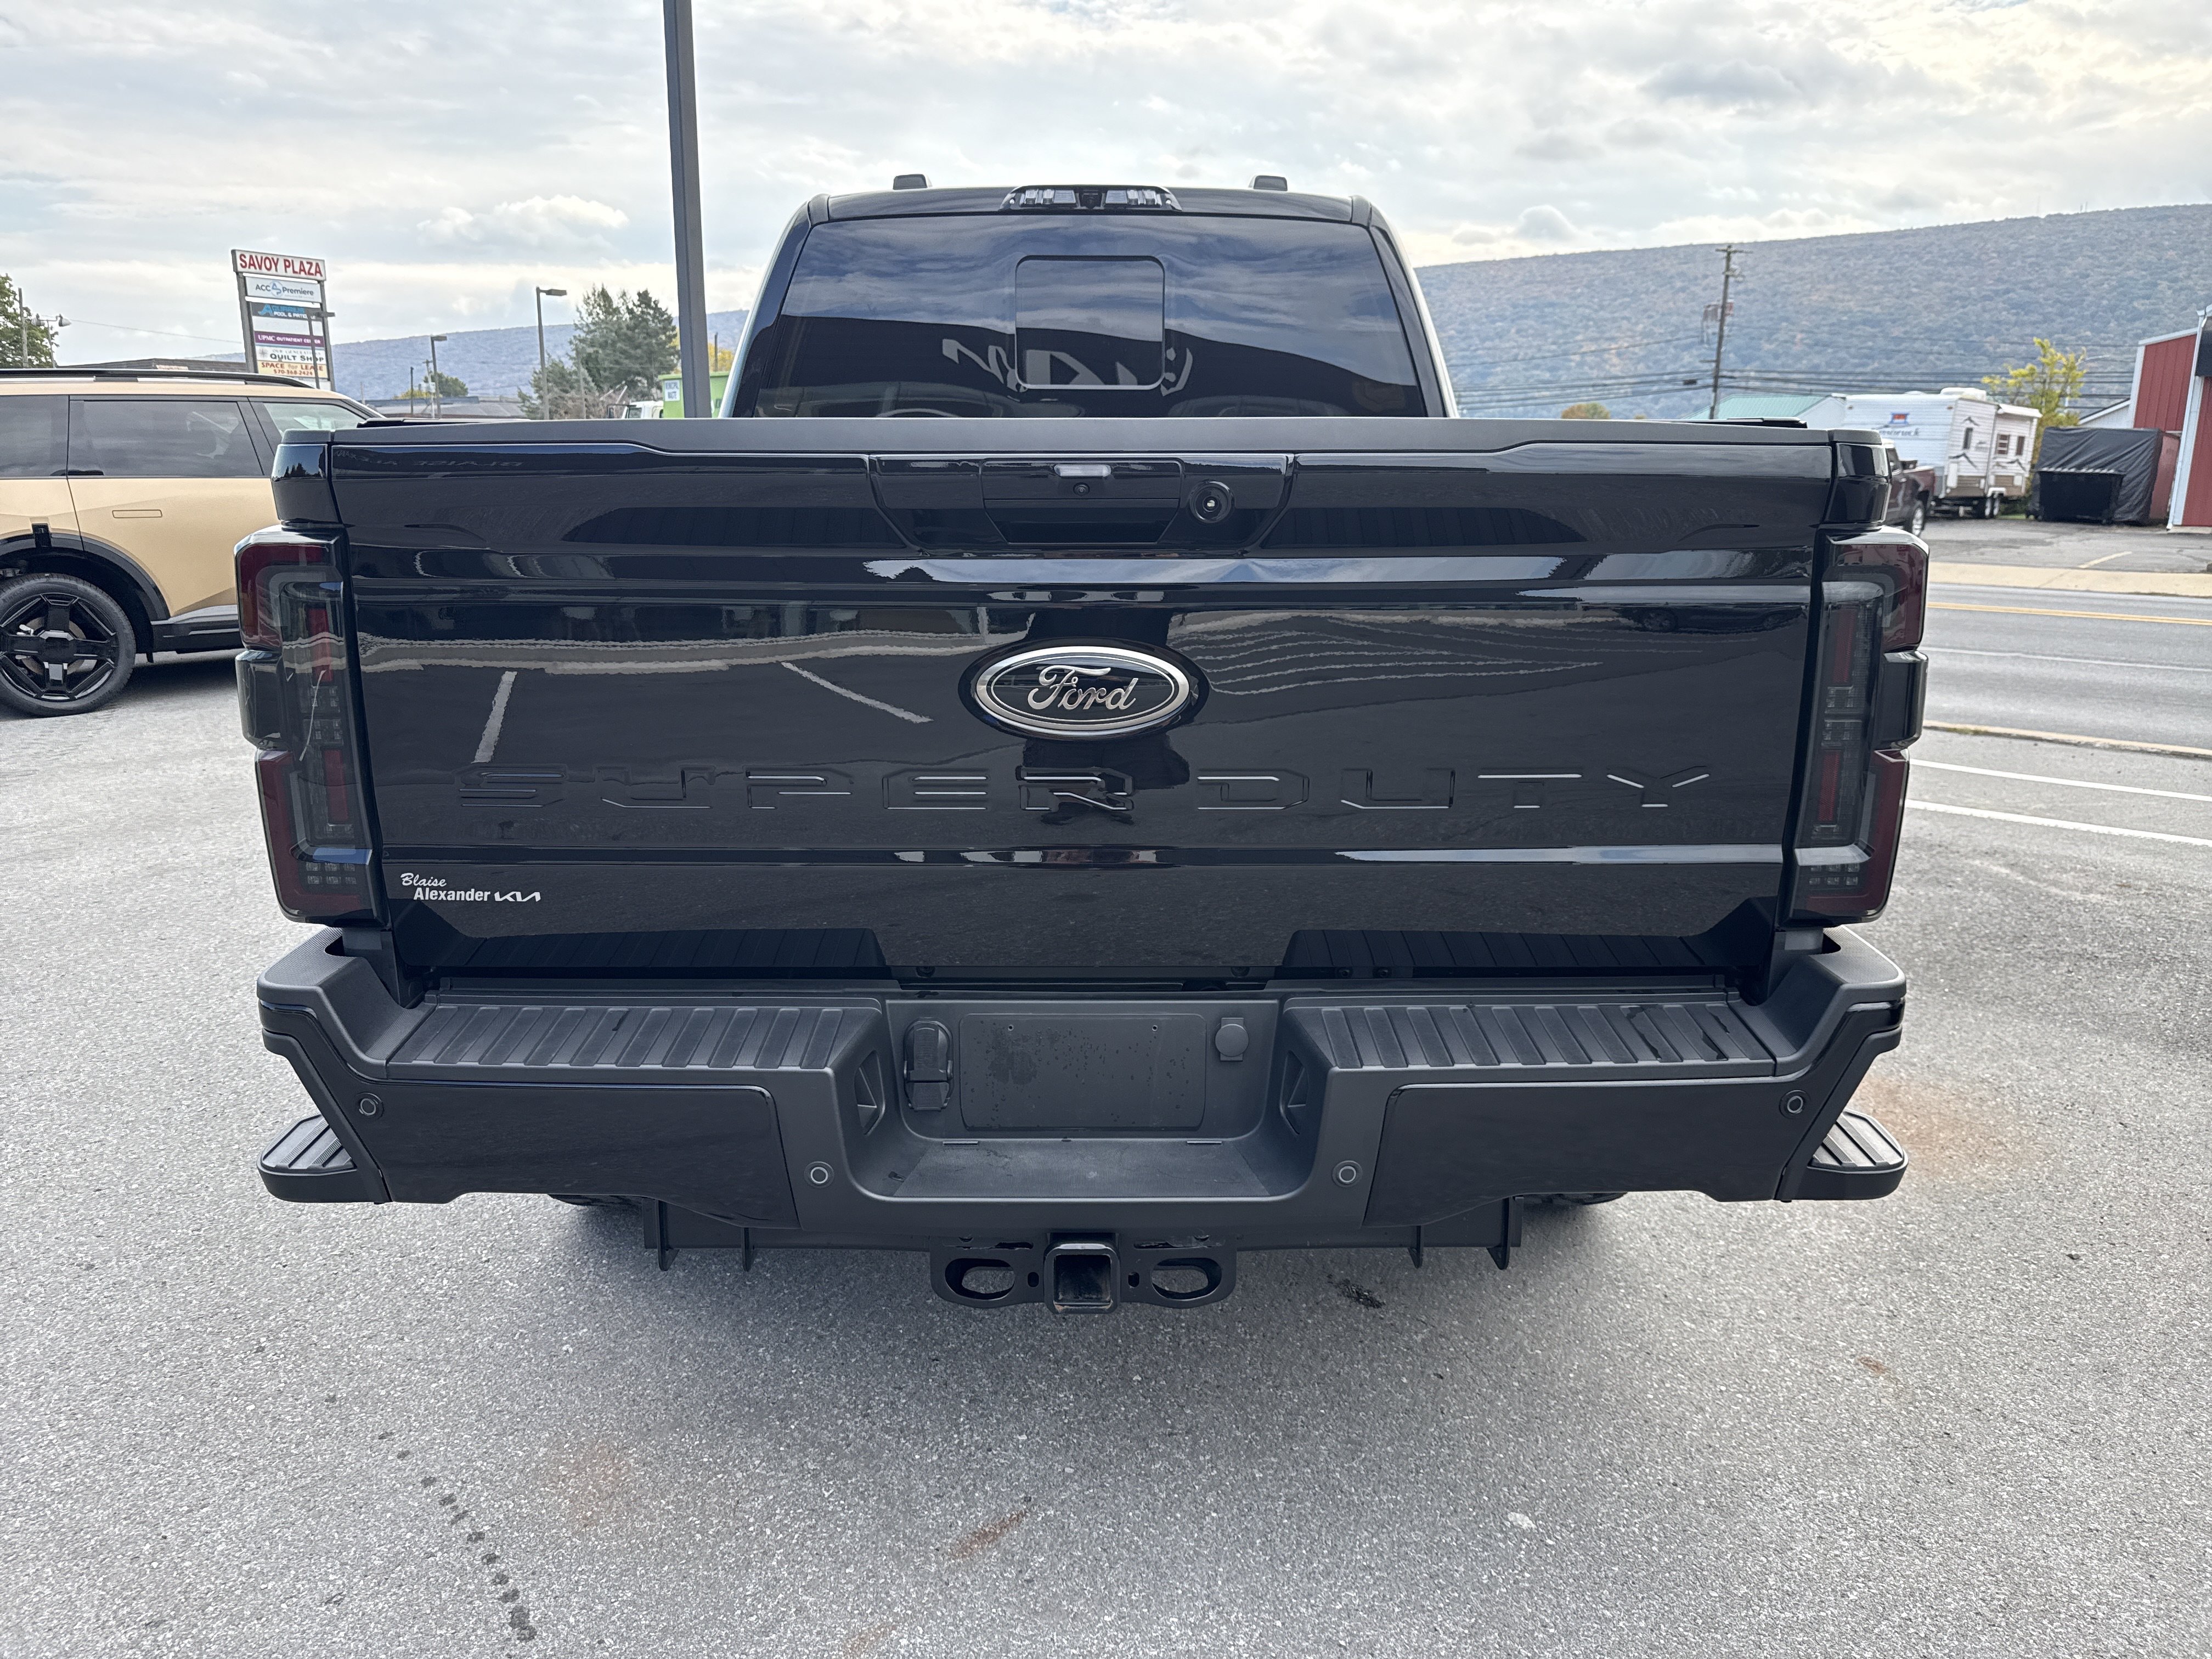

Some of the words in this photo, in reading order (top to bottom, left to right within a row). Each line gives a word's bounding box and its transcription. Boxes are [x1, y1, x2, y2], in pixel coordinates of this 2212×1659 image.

[239, 253, 279, 272] SAVOY
[284, 259, 323, 277] PLAZA
[283, 286, 314, 296] Premiere
[1028, 665, 1139, 710] Ford
[459, 764, 1133, 812] SUPER
[1197, 766, 1711, 810] DUTY
[400, 873, 447, 887] Blaise
[413, 887, 490, 901] Alexander
